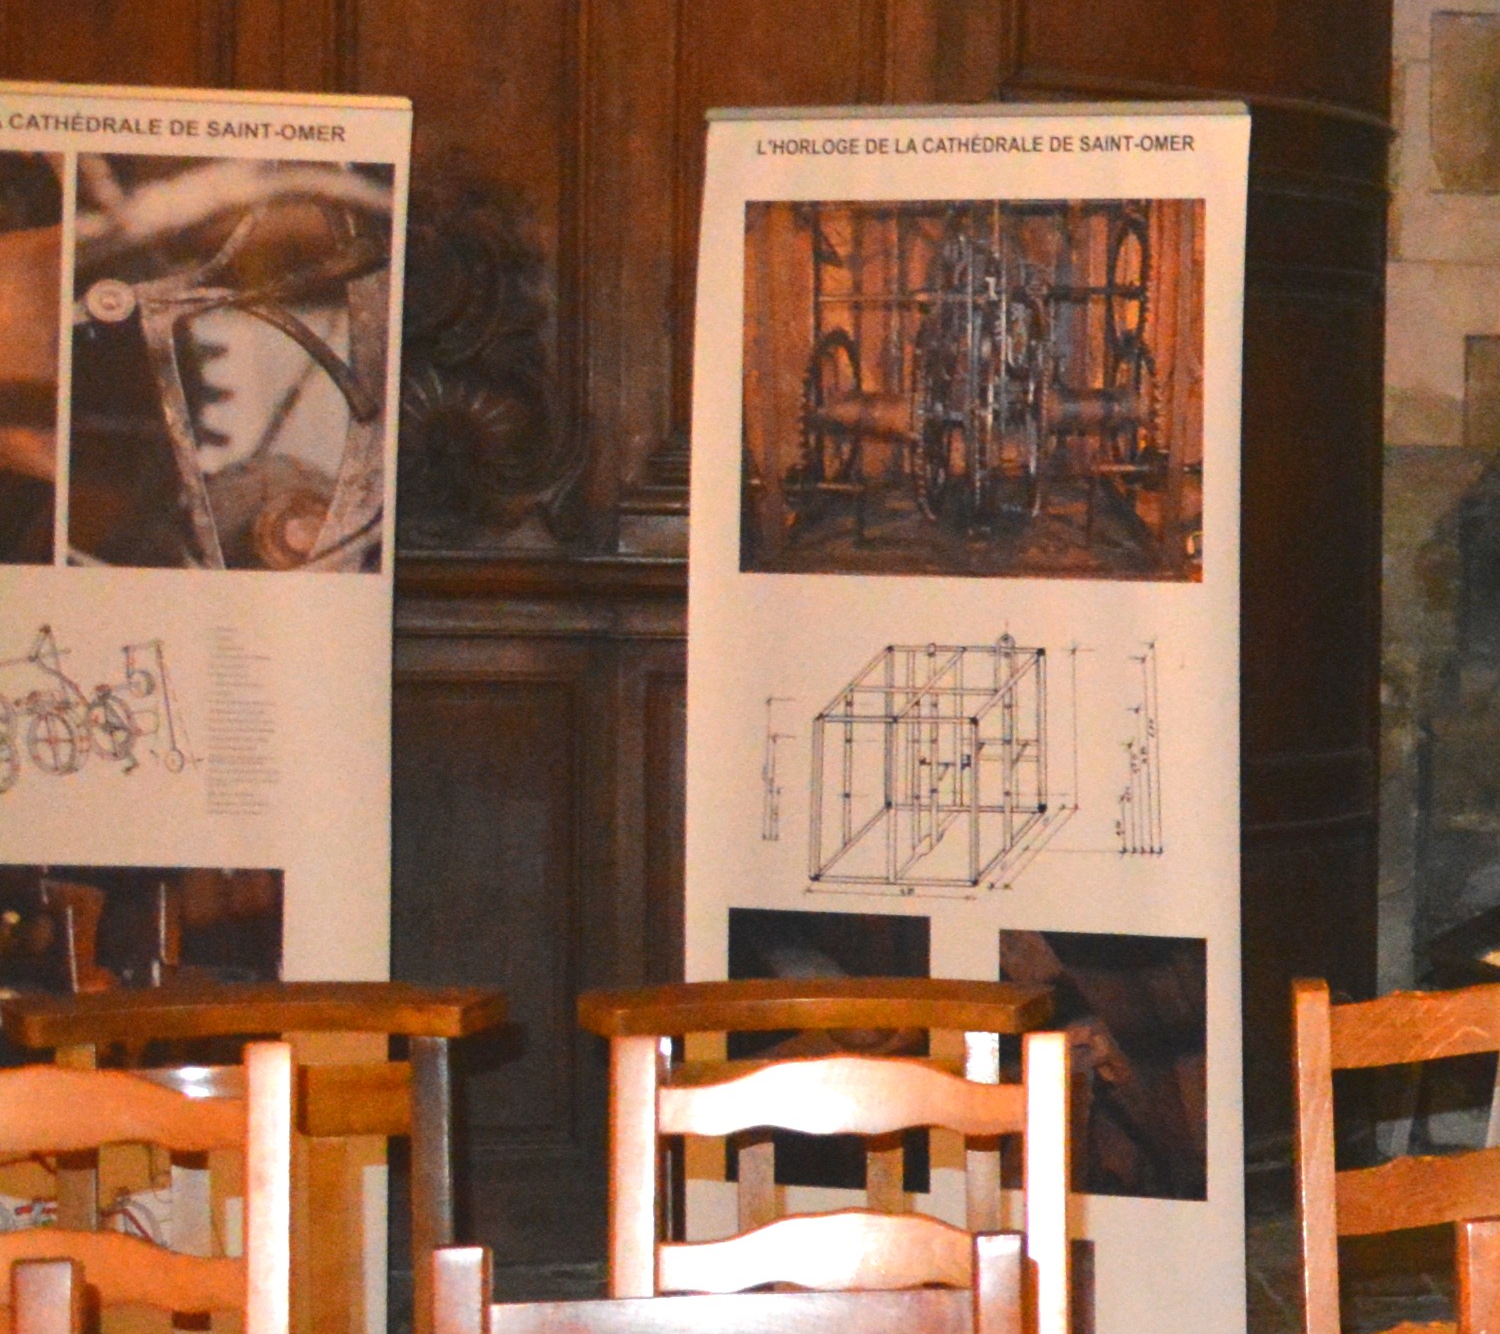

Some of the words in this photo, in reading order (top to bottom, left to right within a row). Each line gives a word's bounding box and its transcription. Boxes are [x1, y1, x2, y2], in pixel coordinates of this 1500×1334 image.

[9, 112, 162, 135] CATHÉDRALE
[169, 120, 199, 136] DE
[207, 121, 346, 142] SAINT-OMER
[757, 138, 859, 155] L'HORLOGE
[865, 138, 889, 155] DE
[895, 137, 917, 154] LA
[922, 134, 1042, 154] CATHÉDRALE
[1050, 136, 1073, 152] DE
[1080, 134, 1195, 152] SAINT-OMER
